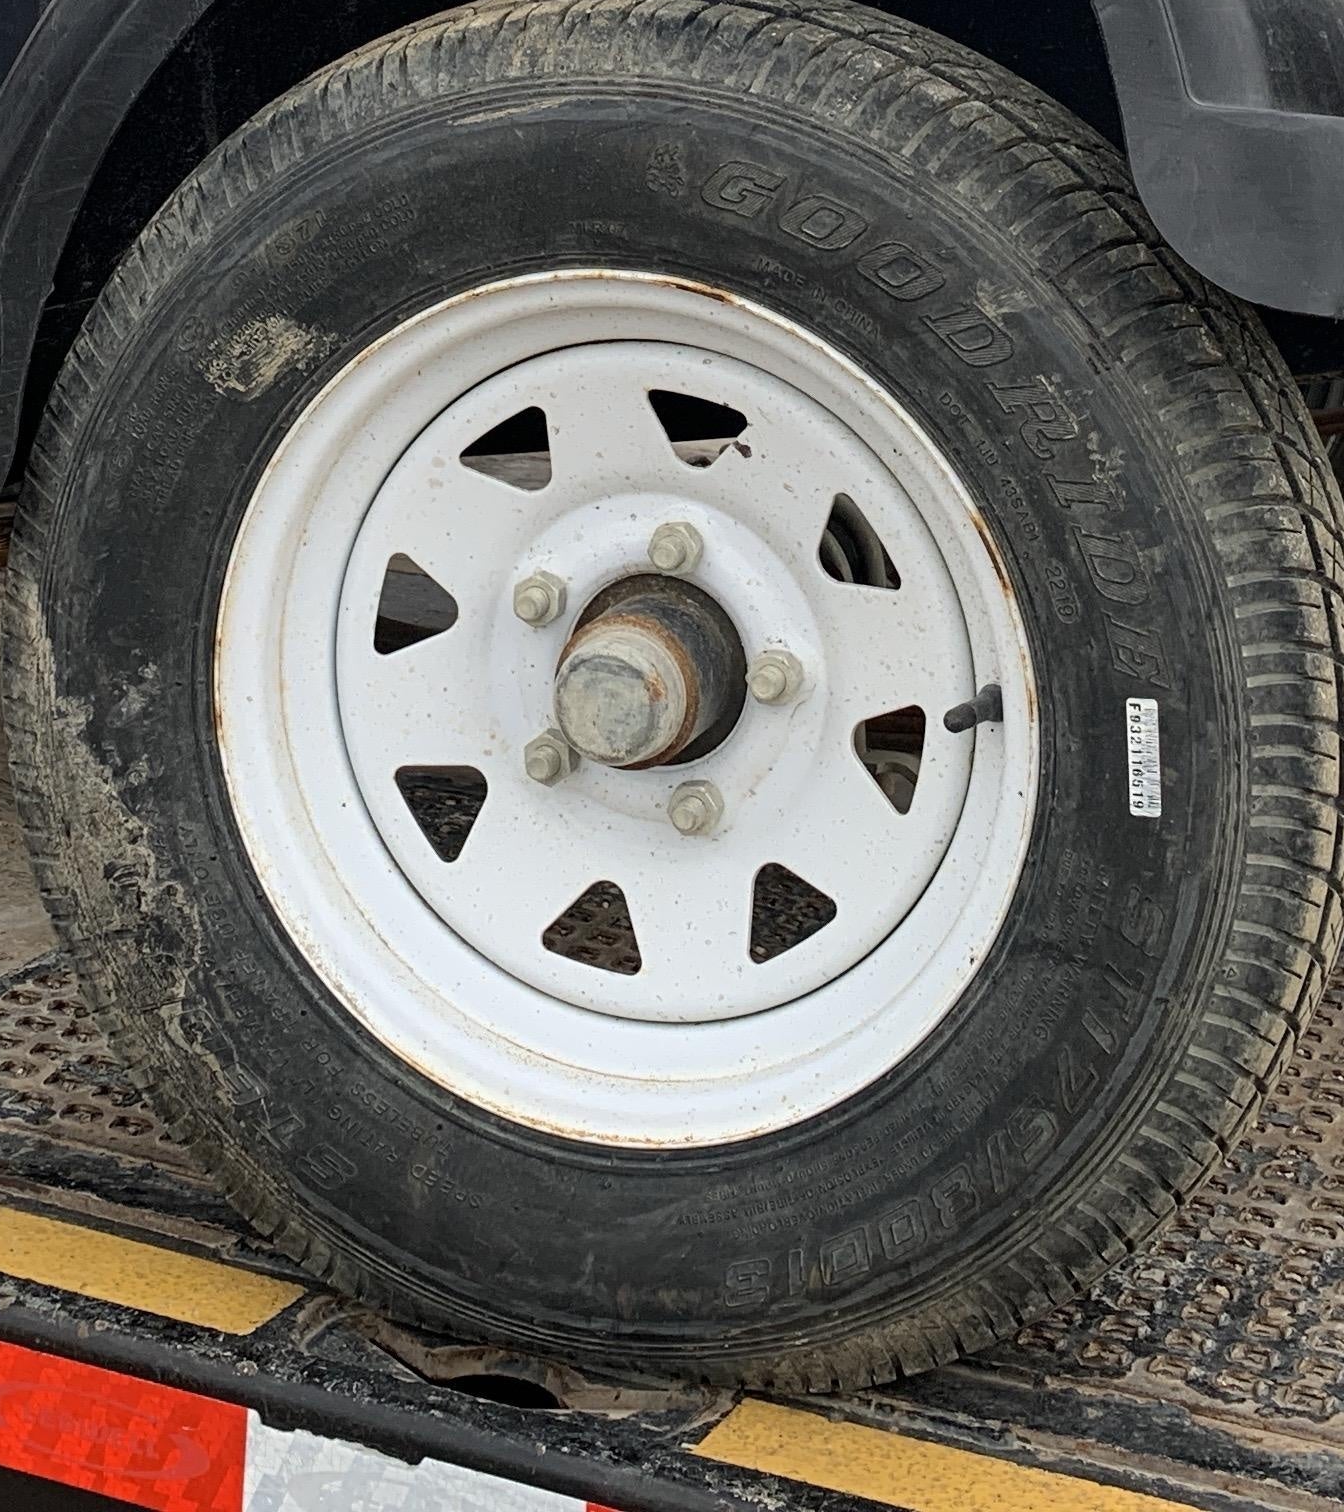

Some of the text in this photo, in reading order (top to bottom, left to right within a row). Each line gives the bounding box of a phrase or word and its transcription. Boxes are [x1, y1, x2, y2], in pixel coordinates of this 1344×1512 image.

[753, 254, 887, 343] MADE IN CHINA
[700, 160, 1174, 688] GOODRIDE
[936, 387, 975, 432] DOT
[1042, 562, 1075, 619] 2219
[203, 888, 238, 940] USE
[299, 1030, 348, 1081] FOR
[324, 1101, 402, 1166] RATING
[346, 1078, 456, 1158] TUBELESS
[405, 1158, 486, 1210] SPEED
